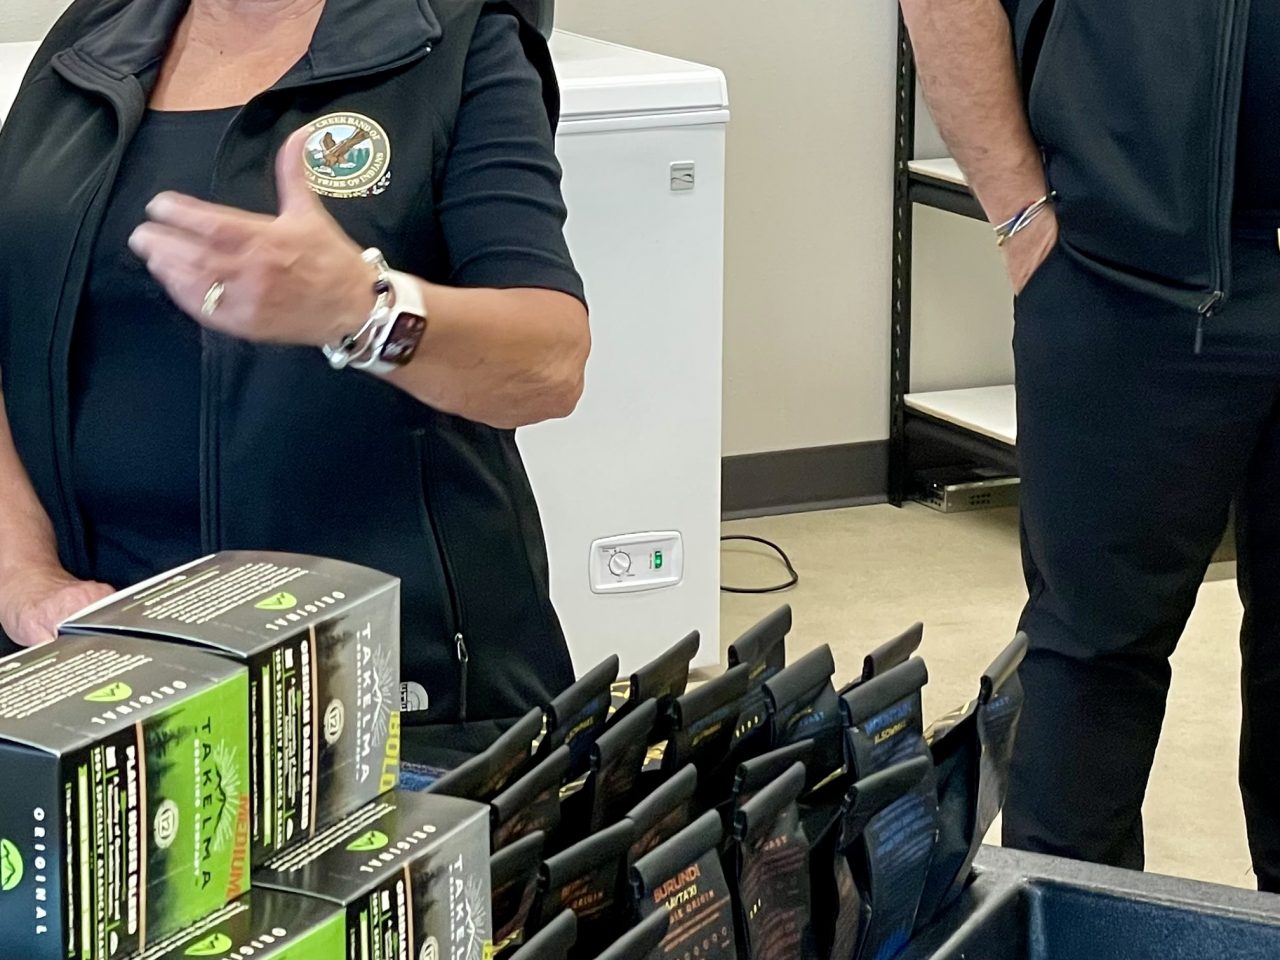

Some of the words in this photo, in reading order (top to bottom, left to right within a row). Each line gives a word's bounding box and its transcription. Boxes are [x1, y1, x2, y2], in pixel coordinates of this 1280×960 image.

[316, 116, 347, 130] CREEK
[348, 117, 371, 135] BAND
[369, 129, 382, 140] OF
[317, 178, 347, 188] TRIBE
[360, 152, 384, 184] INDIANS
[265, 591, 347, 631] ORIGINAL
[91, 679, 188, 725] ORIGINAL
[360, 622, 371, 783] TAKELMA
[379, 711, 400, 793] BOLD
[96, 785, 104, 855] SPECIALTY
[201, 716, 212, 890] TAKELMA
[32, 806, 47, 935] ORIGINAL
[128, 809, 137, 873] HOUSE
[226, 792, 248, 899] MEDIUM
[360, 824, 437, 873] ORIGINAL
[128, 873, 137, 935] BLEND
[653, 863, 701, 904] BURUNDI
